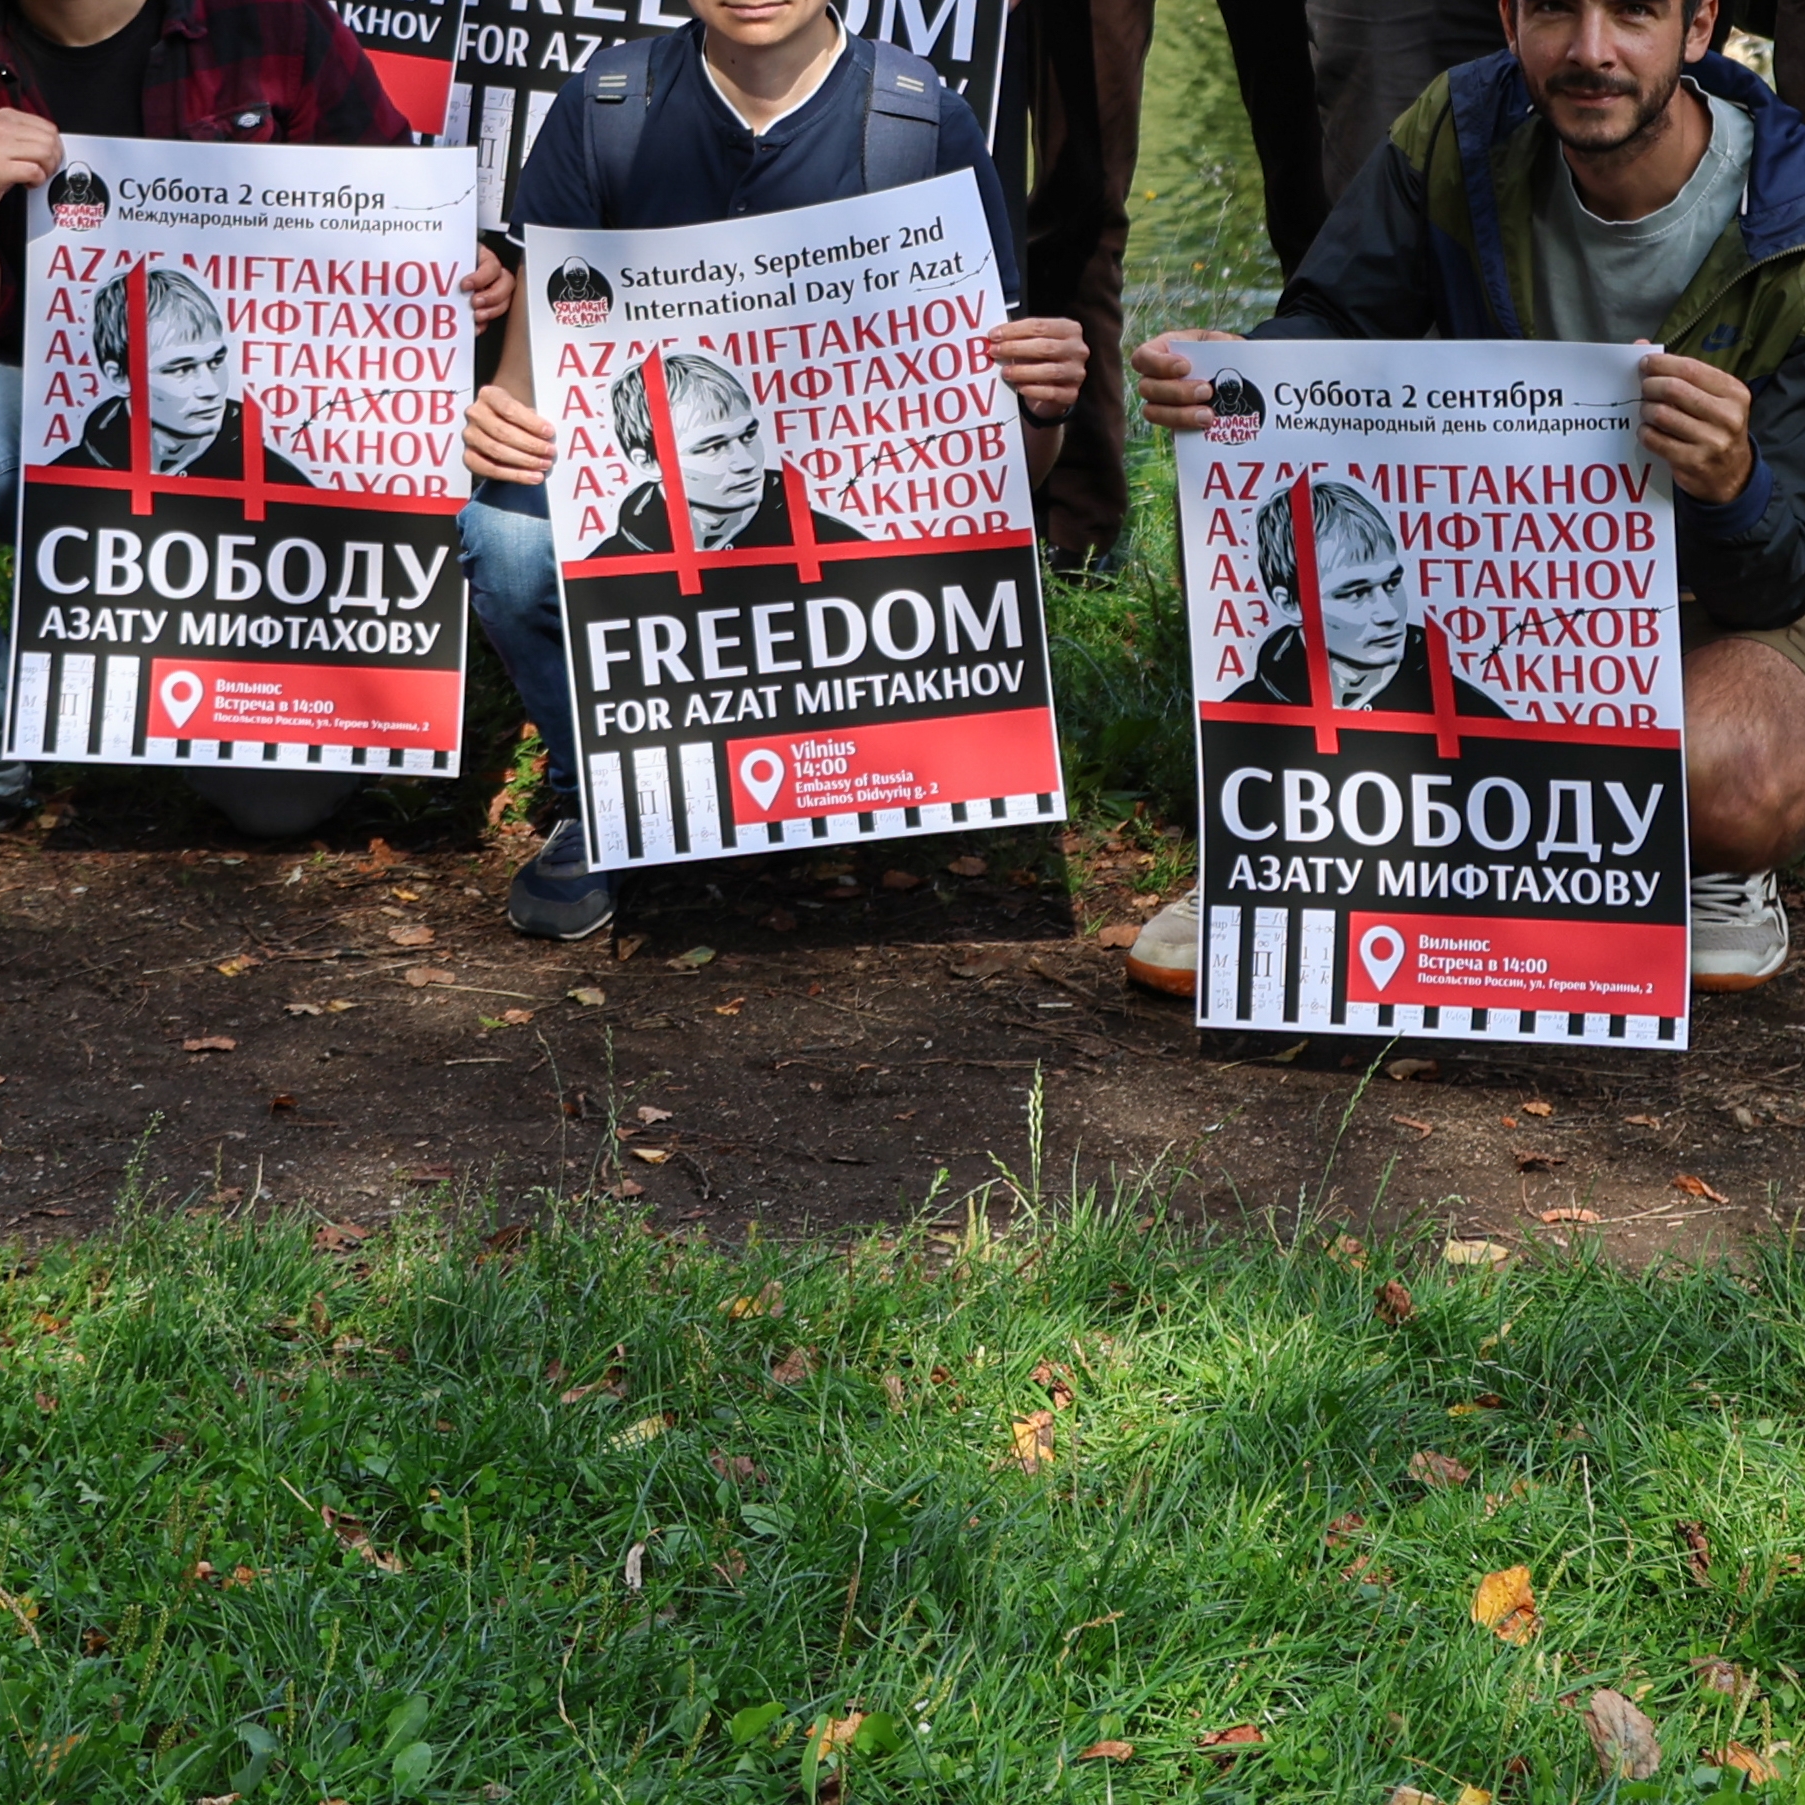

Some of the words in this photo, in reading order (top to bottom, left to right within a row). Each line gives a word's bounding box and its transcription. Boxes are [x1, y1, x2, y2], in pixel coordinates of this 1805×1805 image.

[459, 21, 528, 68] FOR
[119, 177, 228, 207] Суббота
[238, 183, 252, 205] 2
[260, 184, 385, 216] сентября
[118, 205, 266, 229] Международный
[272, 216, 314, 230] день
[319, 212, 444, 238] солидарности
[619, 259, 744, 288] Saturday,
[753, 234, 890, 277] September
[898, 215, 943, 249] 2nd
[624, 281, 796, 321] International
[805, 278, 854, 304] Day
[862, 267, 899, 292] for
[908, 251, 963, 284] Azat
[1274, 380, 1392, 414] Суббота
[1401, 384, 1417, 408] 2
[1426, 380, 1563, 415] сентября
[1275, 412, 1435, 436] Международный
[1441, 419, 1487, 435] день
[1492, 411, 1631, 437] солидарности
[38, 525, 448, 615] СВОБОДУ
[39, 605, 168, 643] АЗАТУ
[179, 611, 439, 655] МИФТАХОВУ
[585, 579, 1022, 691] FREEDOM
[215, 678, 282, 694] Вильнюс
[594, 697, 672, 736] FOR
[683, 684, 782, 727] AZAT
[794, 659, 1024, 715] MIFTAKHOV
[214, 695, 275, 712] Встреча
[278, 700, 288, 712] в
[292, 698, 334, 713] 14:00
[790, 738, 856, 760] Vilnius
[793, 756, 847, 778] 14:00
[794, 778, 851, 793] Embassy
[853, 772, 868, 787] of
[871, 769, 913, 785] Russia
[796, 789, 854, 808] Ukrainos
[913, 785, 927, 799] g.
[929, 781, 939, 794] 2
[1220, 766, 1663, 862] СВОБОДУ
[1227, 854, 1363, 894] АЗАТУ
[1377, 859, 1660, 906] МИФТАХОВУ
[1418, 933, 1490, 952] Вильнюс
[1417, 953, 1483, 972] Встреча
[1487, 959, 1497, 971] в
[1502, 956, 1547, 973] 14:00
[1417, 970, 1482, 985] Посольство
[1483, 975, 1526, 988] России,
[1529, 979, 1545, 991] ул.
[1548, 978, 1586, 992] Героев
[1589, 979, 1642, 994] Украины,
[1645, 982, 1653, 994] 2
